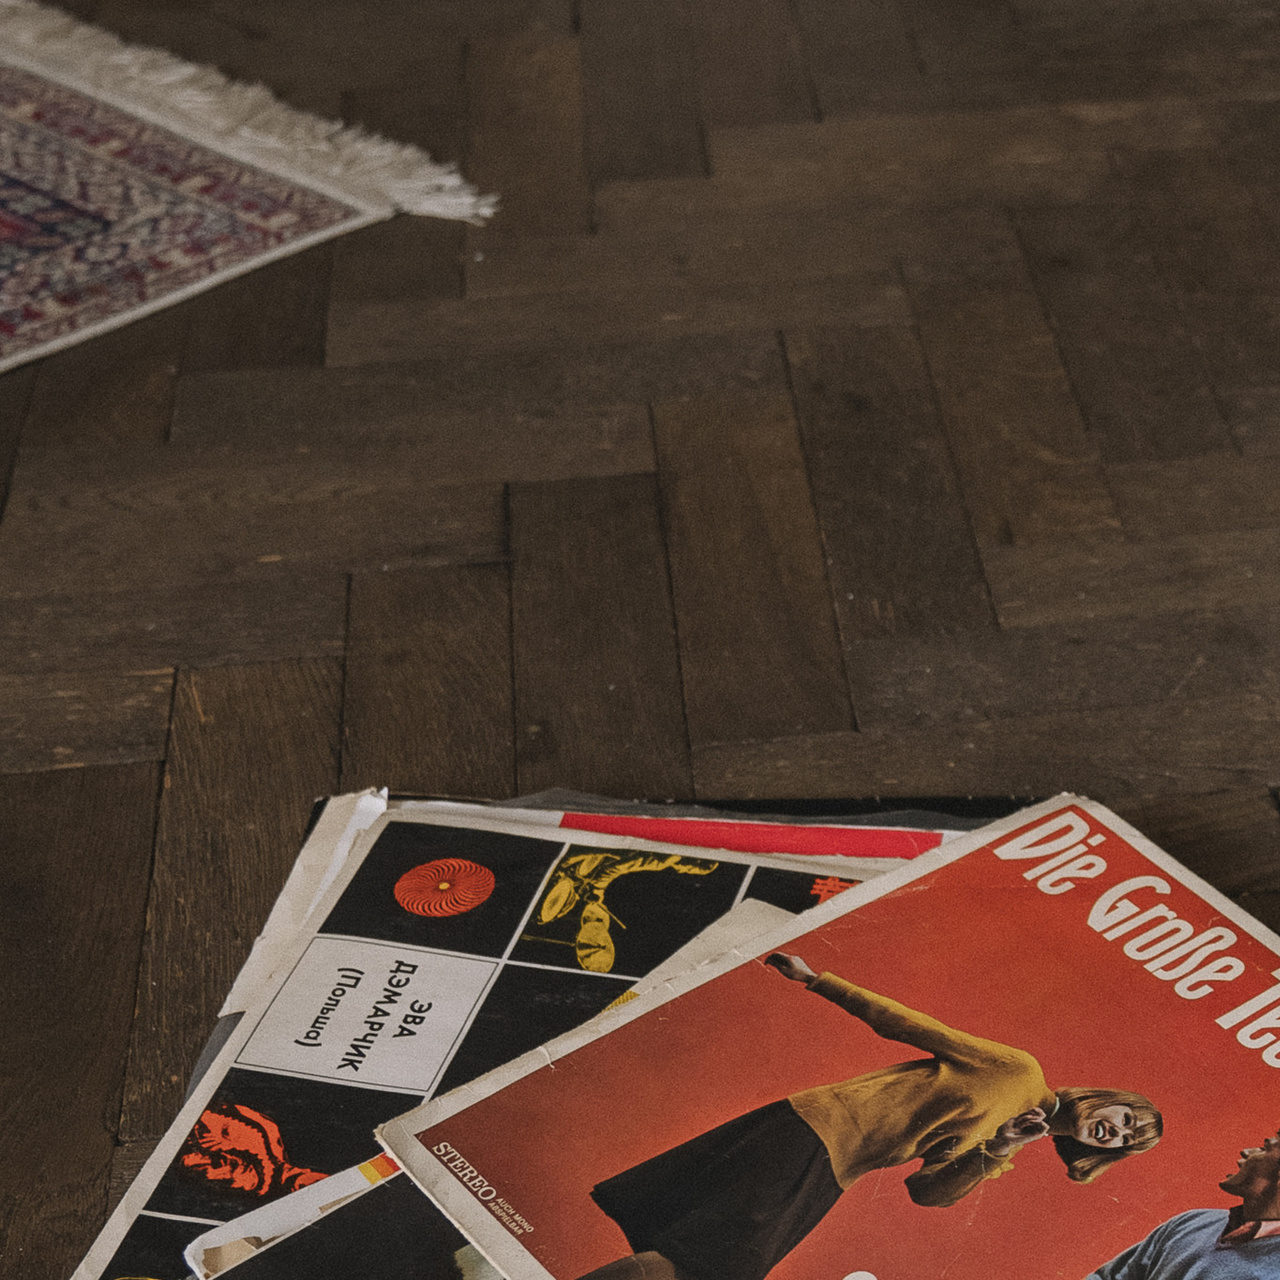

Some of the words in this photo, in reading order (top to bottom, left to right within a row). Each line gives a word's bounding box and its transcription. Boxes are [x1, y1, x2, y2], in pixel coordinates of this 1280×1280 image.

[994, 811, 1107, 895] Die
[1088, 875, 1246, 1000] Große
[294, 967, 365, 1047] (Польша)
[336, 960, 419, 1072] ДЭМАРЧИК
[392, 999, 433, 1038] ЭВА
[432, 1141, 497, 1201] STEREO
[487, 1202, 524, 1235] ABSPIELBAR
[496, 1198, 517, 1216] AUCH
[513, 1213, 535, 1234] MONO
